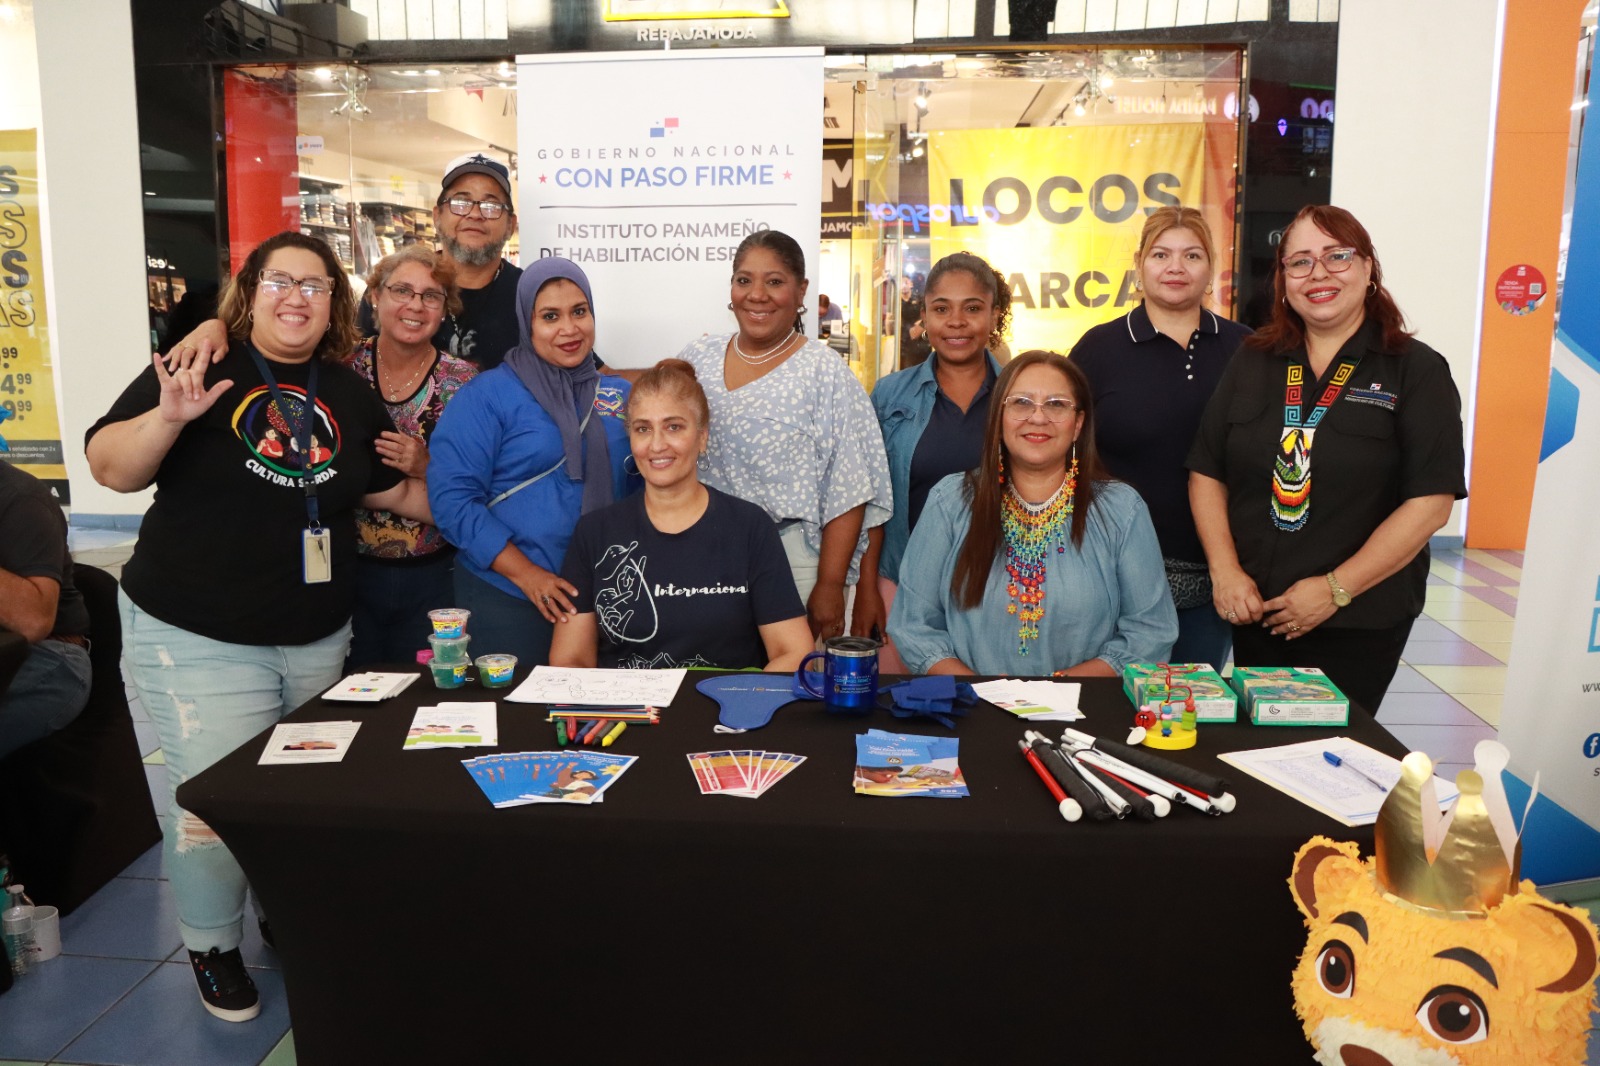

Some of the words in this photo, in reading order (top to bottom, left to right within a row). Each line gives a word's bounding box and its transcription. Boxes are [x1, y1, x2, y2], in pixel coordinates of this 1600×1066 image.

[637, 26, 757, 41] REBAJAMODA
[538, 147, 656, 160] GOBIERNO
[674, 144, 794, 157] NACIONAL
[555, 167, 611, 188] CON
[621, 166, 688, 188] PASO
[696, 164, 774, 187] FIRME
[950, 172, 1181, 227] LOCOS
[557, 223, 658, 239] INSTITUTO
[540, 248, 563, 259] DE
[569, 243, 700, 262] HABILITACIÓN
[245, 459, 295, 488] CULTURA
[298, 467, 338, 488] SRDA
